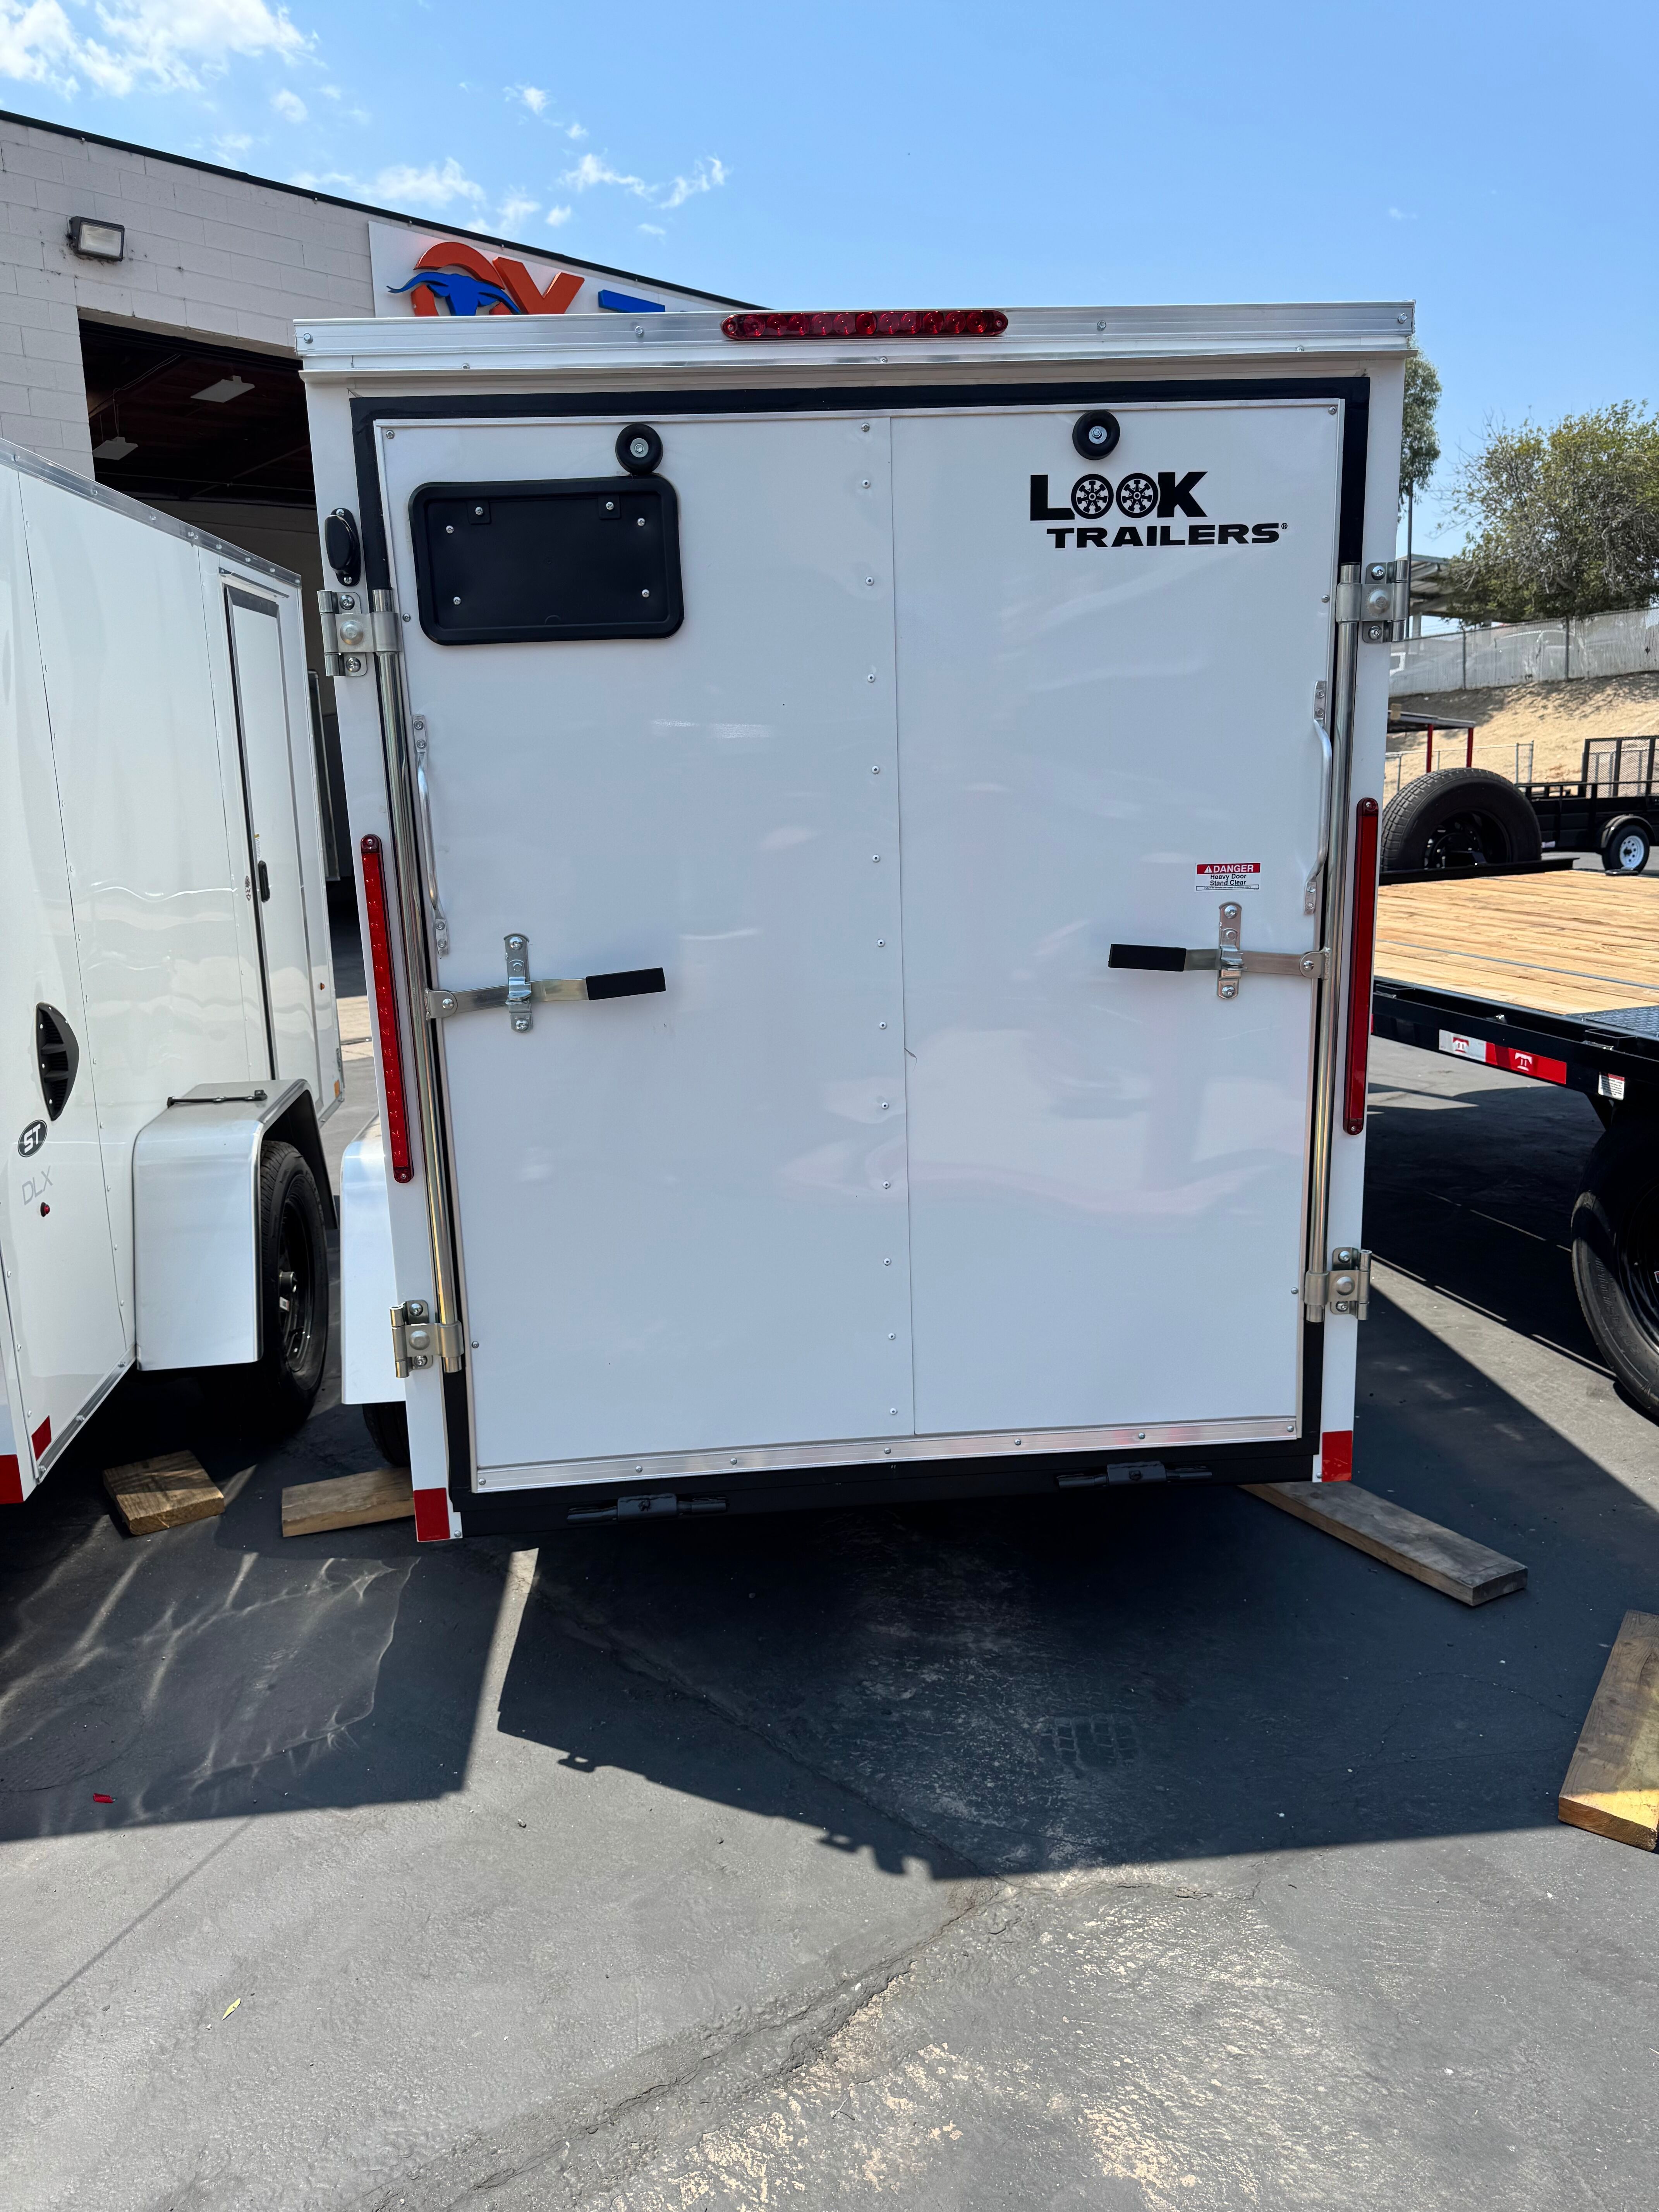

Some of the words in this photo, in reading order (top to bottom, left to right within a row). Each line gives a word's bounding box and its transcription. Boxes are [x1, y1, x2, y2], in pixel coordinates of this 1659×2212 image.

[1030, 471, 1208, 521] LOOK
[1213, 864, 1254, 873] DANGER
[24, 1123, 41, 1153] ST
[22, 1165, 53, 1205] DLX
